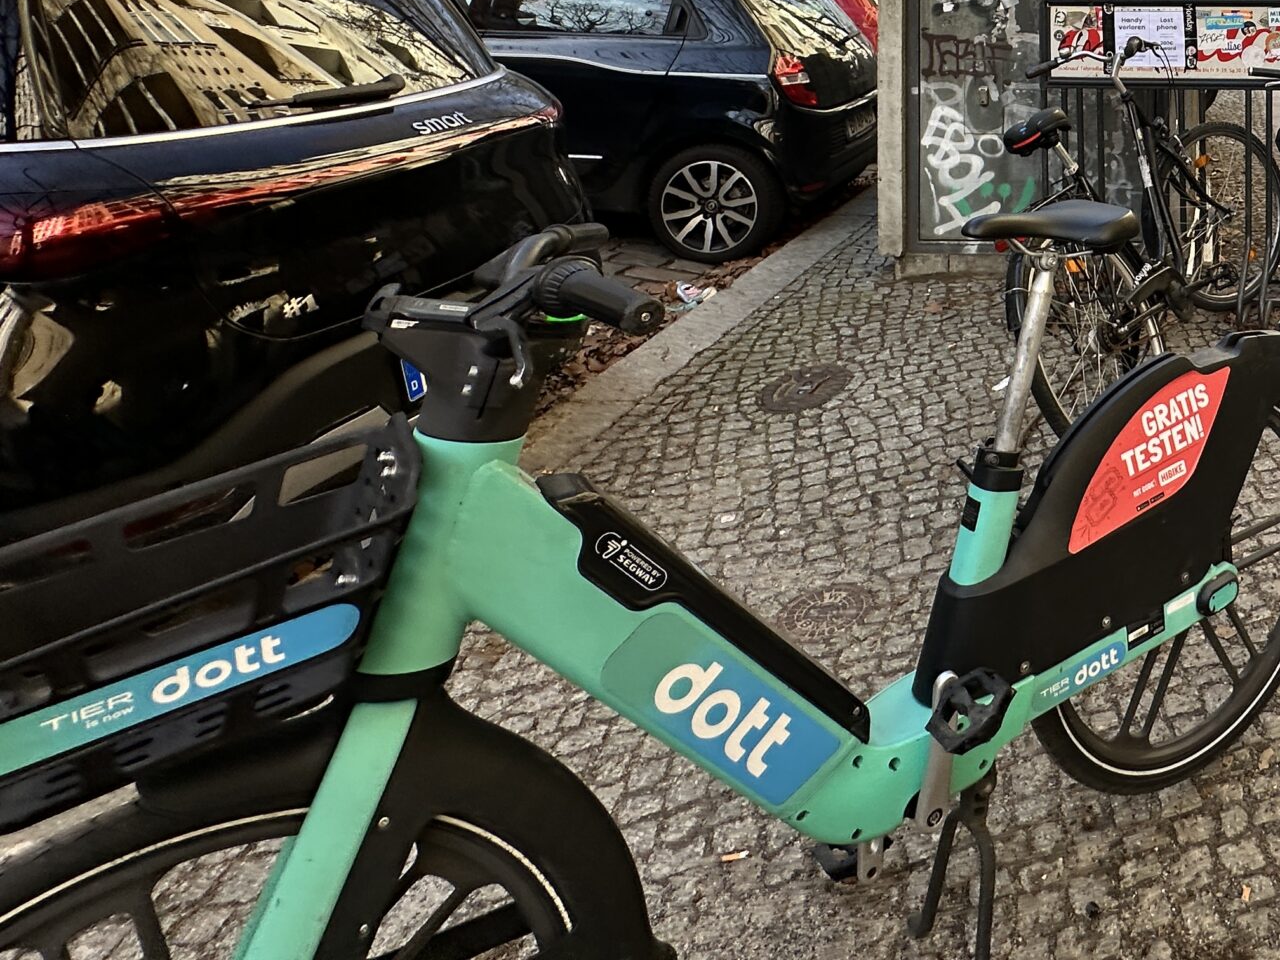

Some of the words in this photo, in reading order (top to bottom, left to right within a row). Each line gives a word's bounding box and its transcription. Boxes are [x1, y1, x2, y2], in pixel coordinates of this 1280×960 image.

[1121, 17, 1143, 25] Handy
[1156, 23, 1178, 31] phone
[412, 111, 473, 135] smart
[411, 380, 419, 391] D
[1141, 383, 1210, 437] GRATIS
[1120, 414, 1205, 477] TESTEN!
[1160, 463, 1184, 482] HIBIKE
[616, 554, 656, 585] SEGWAY
[623, 548, 652, 572] POWERED
[651, 569, 662, 578] BY
[151, 635, 286, 704] dott
[1074, 648, 1119, 686] dott
[1040, 677, 1070, 697] TIER
[40, 691, 134, 731] TIER
[85, 718, 99, 729] is
[101, 706, 134, 726] now
[654, 661, 792, 778] dott
